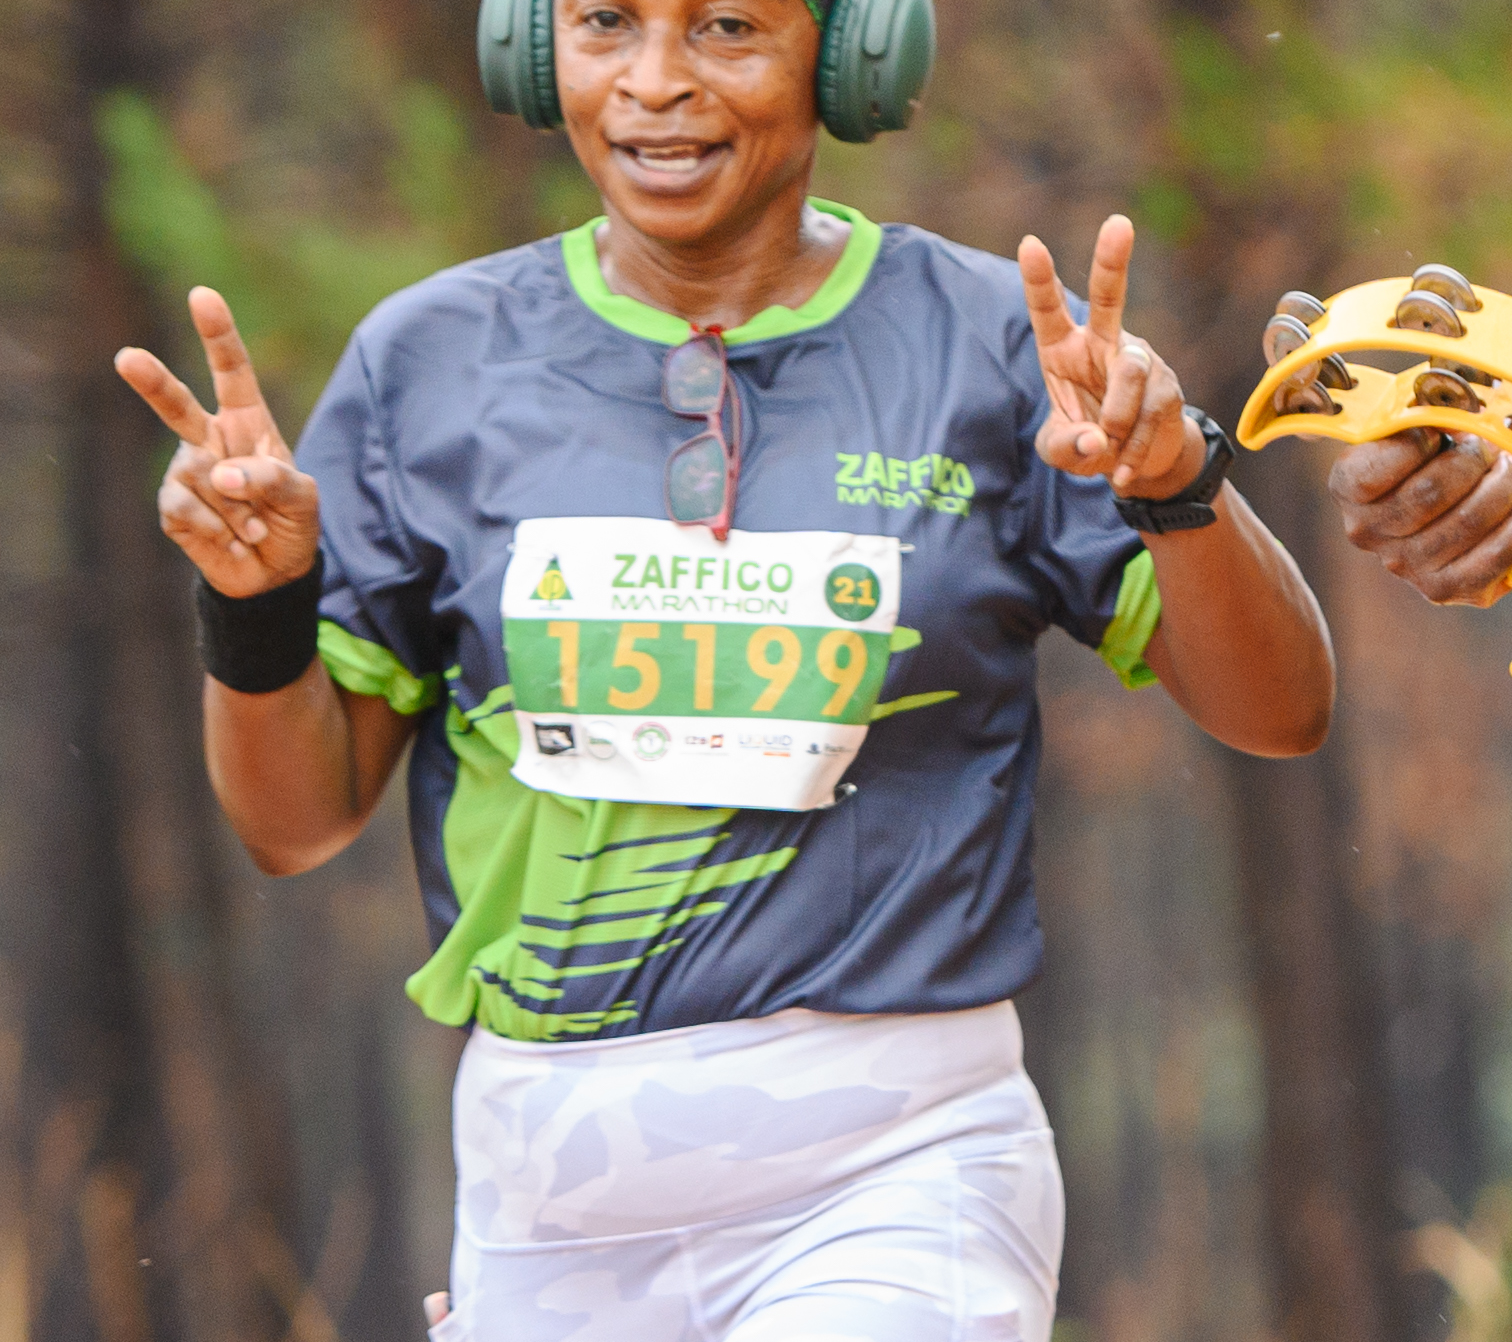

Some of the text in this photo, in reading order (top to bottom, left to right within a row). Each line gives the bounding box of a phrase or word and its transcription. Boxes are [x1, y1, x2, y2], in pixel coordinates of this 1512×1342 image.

[834, 451, 976, 499] ZAFFICO
[611, 593, 789, 616] MARATHON
[612, 554, 876, 608] ZAFFICO 21
[546, 620, 869, 718] 15199
